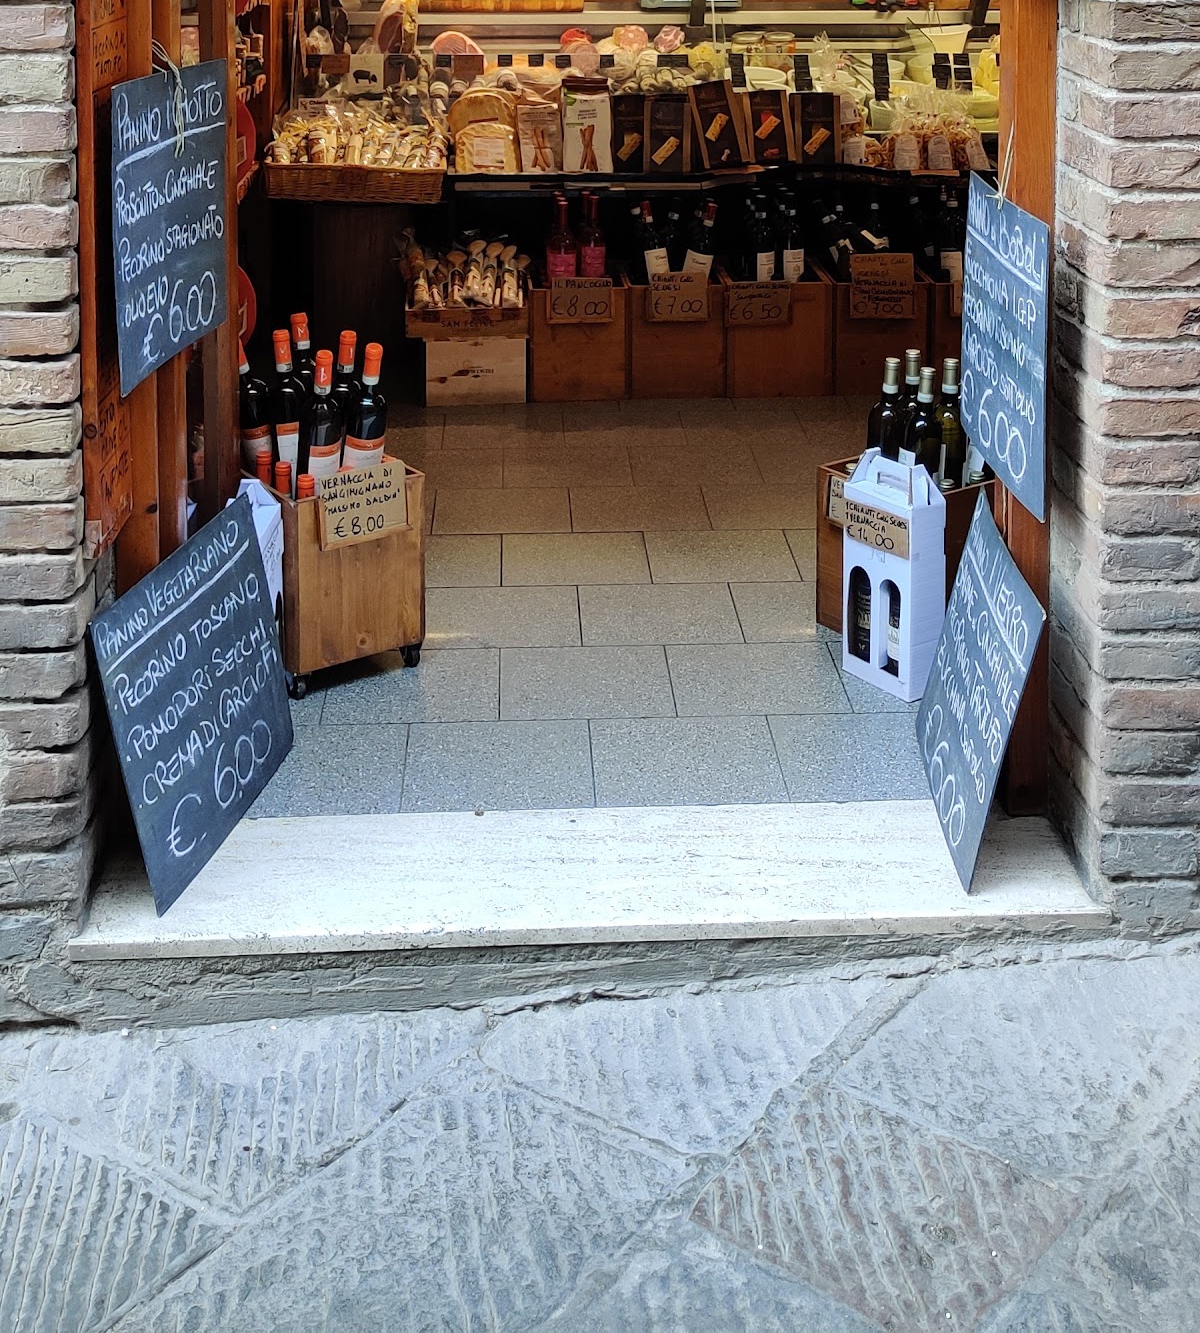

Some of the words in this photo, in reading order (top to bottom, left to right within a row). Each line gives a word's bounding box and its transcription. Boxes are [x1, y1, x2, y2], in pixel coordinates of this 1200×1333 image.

[116, 93, 161, 152] PANINO
[165, 159, 218, 204] CINGHIALE
[118, 236, 165, 283] PECORINO
[166, 204, 224, 254] STAGIONATO
[321, 471, 374, 490] VERNACCIA
[383, 468, 392, 477] DI
[94, 607, 148, 659] PANINO
[144, 520, 239, 617] VEGETARIANO
[113, 633, 187, 715] PECORINO
[976, 610, 1020, 724] CINGHIALE
[126, 665, 213, 759] POMODORI
[142, 728, 204, 804] CREMA
[200, 718, 220, 748] DI
[219, 641, 278, 728] CARCIOFI
